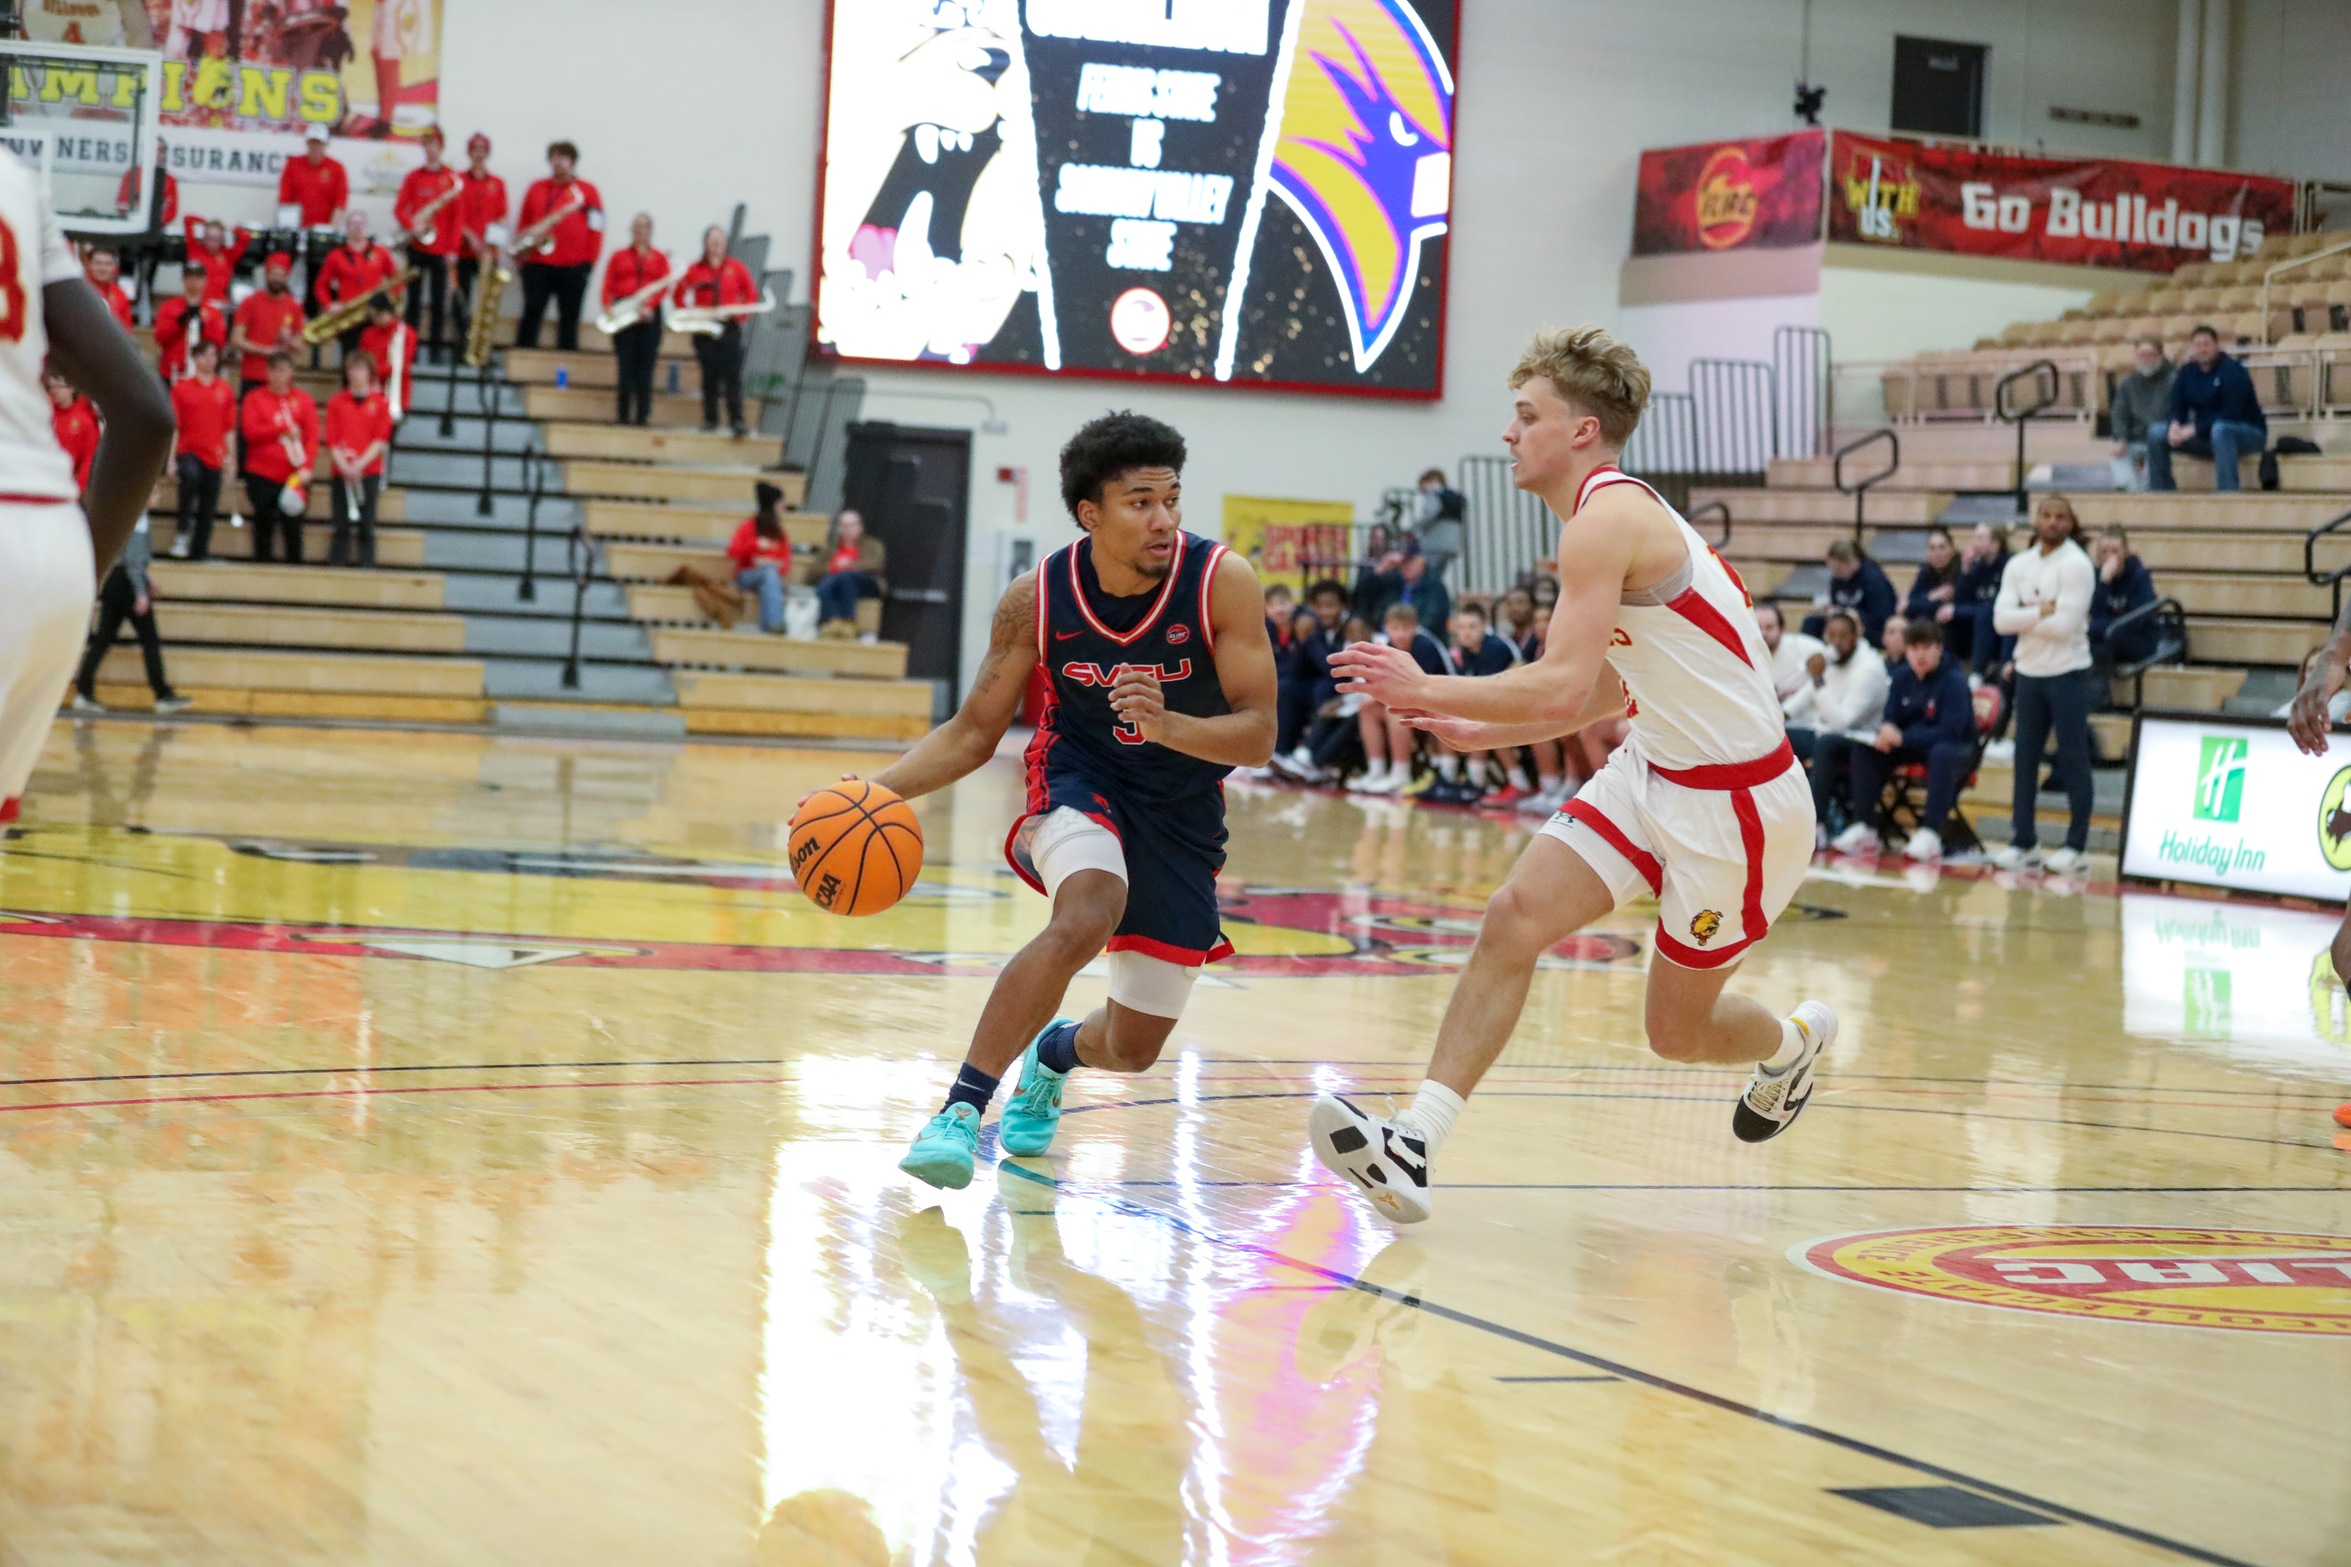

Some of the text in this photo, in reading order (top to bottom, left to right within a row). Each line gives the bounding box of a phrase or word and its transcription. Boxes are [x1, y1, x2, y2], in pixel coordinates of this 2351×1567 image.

[1961, 181, 2265, 263] Go Bulldogs
[2159, 829, 2266, 876] Holiday Inn
